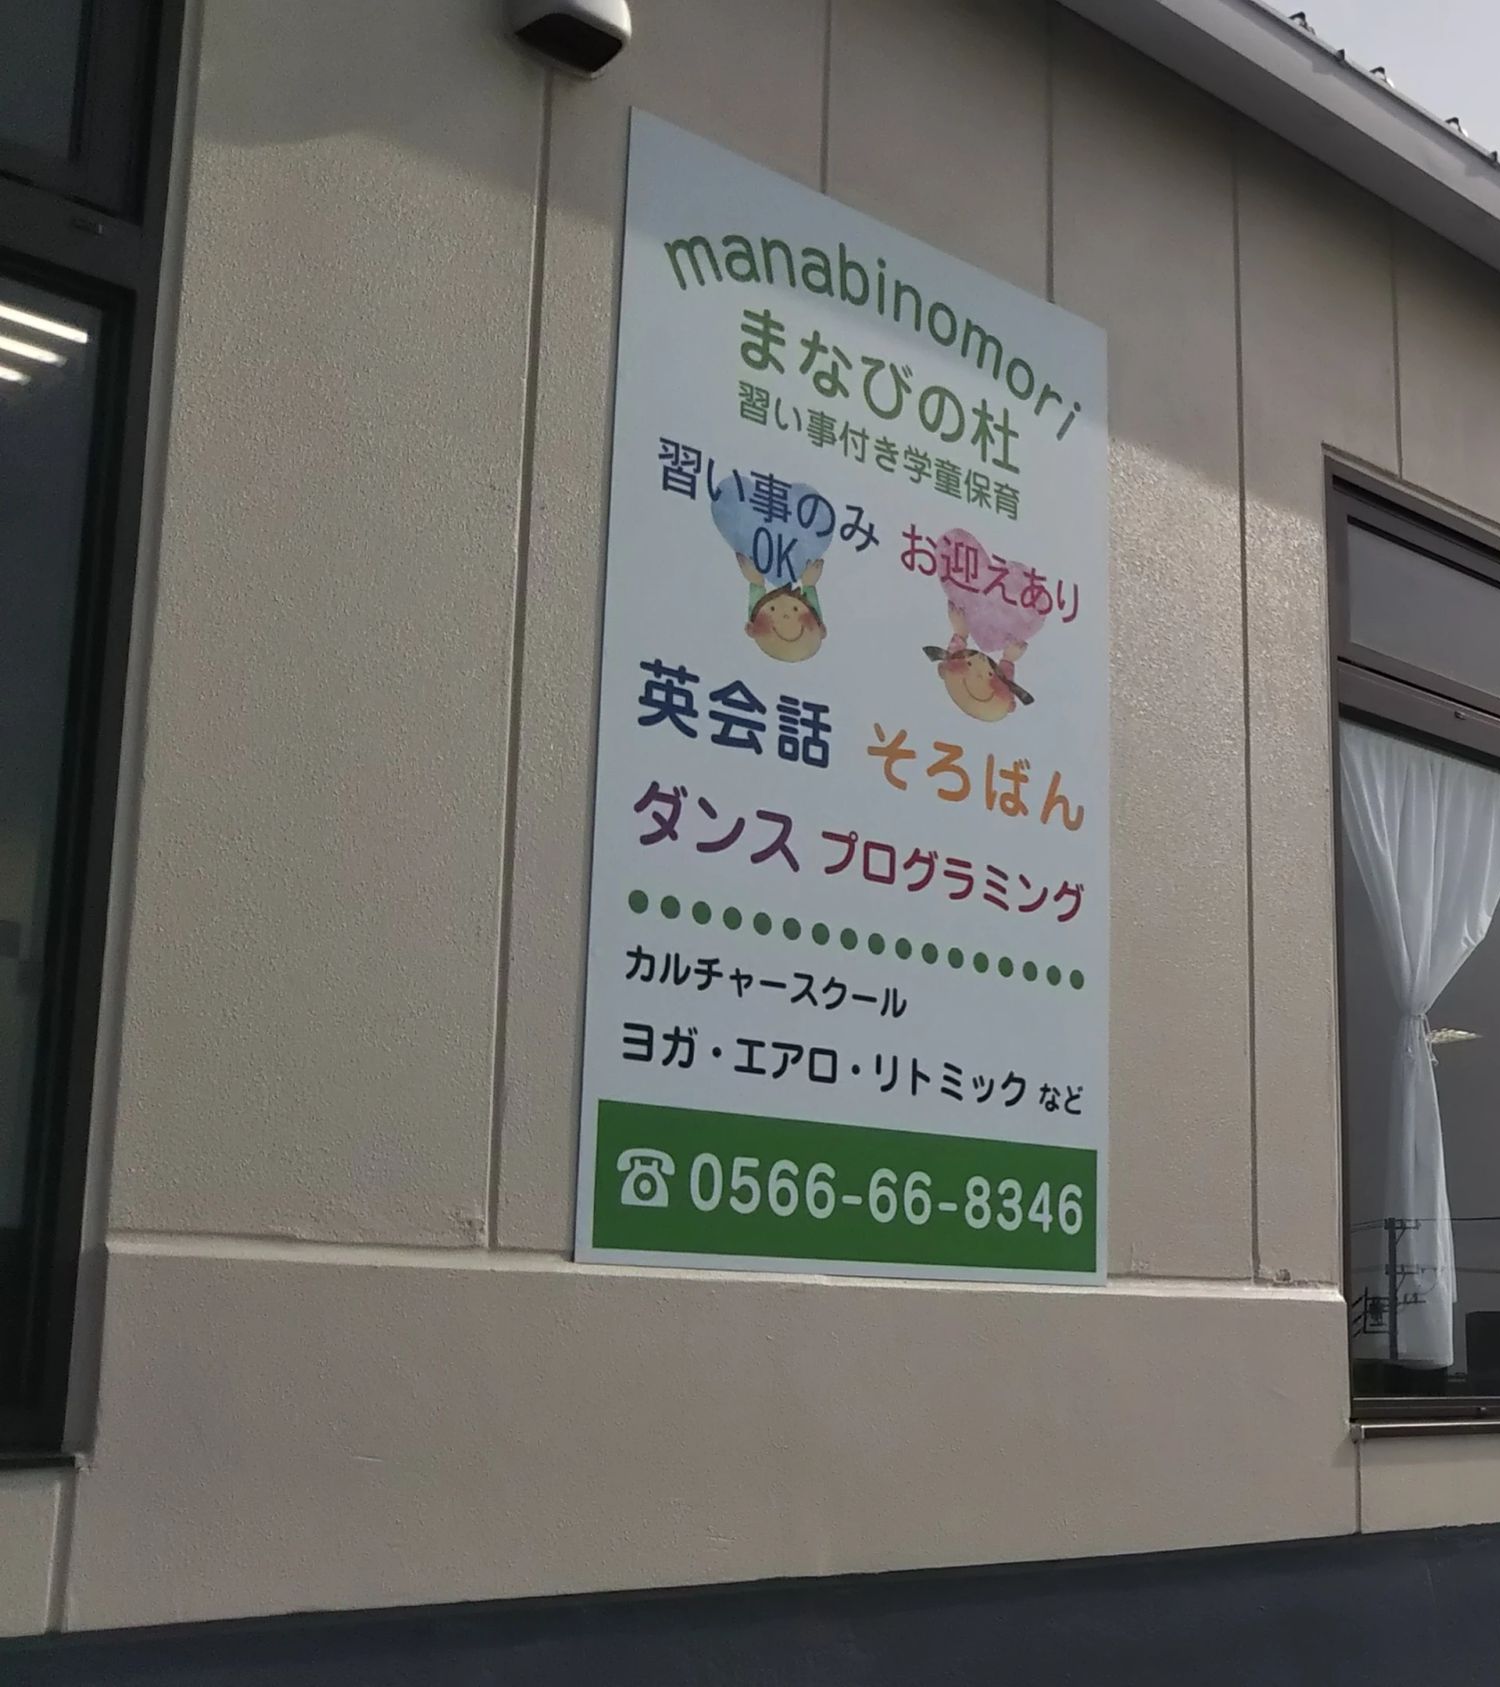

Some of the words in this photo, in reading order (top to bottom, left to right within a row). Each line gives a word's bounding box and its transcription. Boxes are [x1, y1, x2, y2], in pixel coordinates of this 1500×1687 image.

[664, 233, 1082, 441] manabinomori
[739, 308, 1021, 475] まなびの杜
[658, 436, 881, 553] 習い事のみ
[737, 381, 1021, 521] 習い事付き学童保育
[752, 527, 799, 583] OK
[899, 524, 1080, 624] お迎えあり
[637, 658, 833, 770] 英会話
[867, 722, 1085, 831] そろばん
[633, 781, 800, 873] ダンス
[821, 830, 1086, 923] プログラミング
[625, 945, 907, 1018] カルチャースクール
[1039, 1083, 1084, 1116] など
[689, 1152, 1084, 1236] 0566-66-8346
